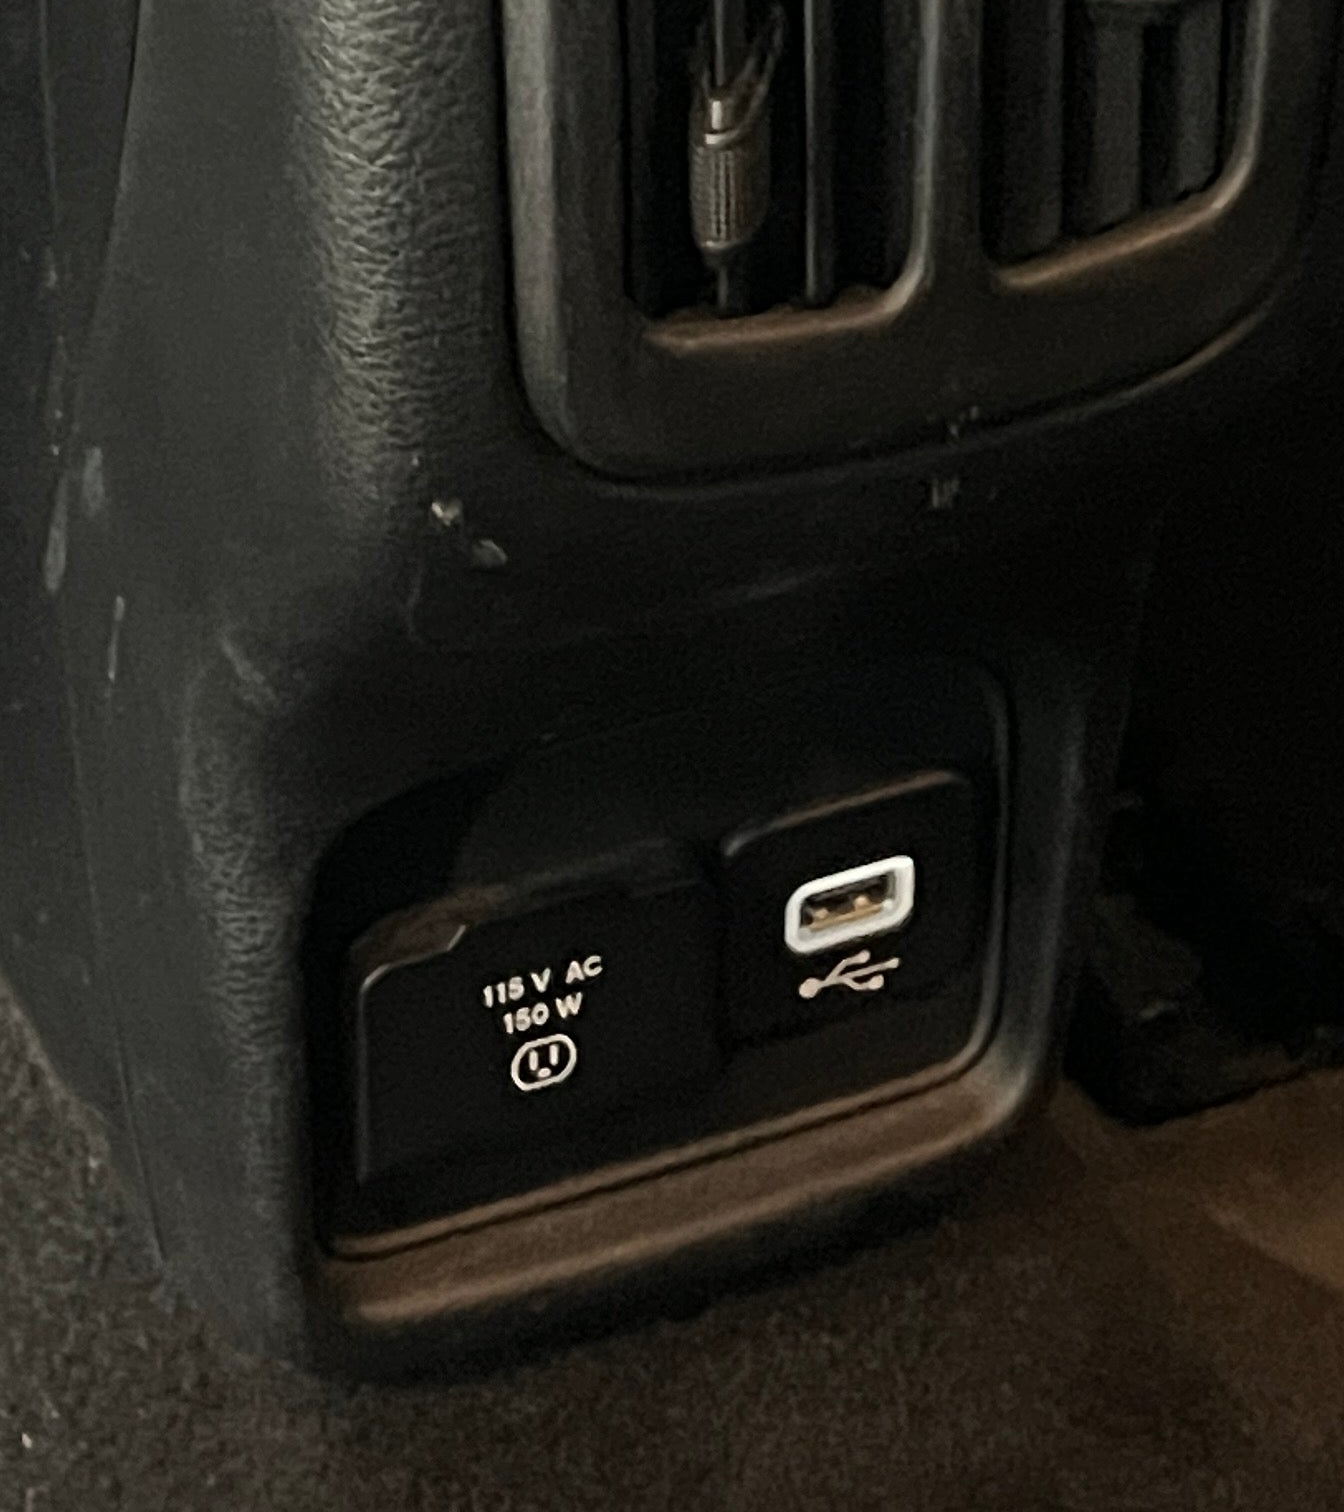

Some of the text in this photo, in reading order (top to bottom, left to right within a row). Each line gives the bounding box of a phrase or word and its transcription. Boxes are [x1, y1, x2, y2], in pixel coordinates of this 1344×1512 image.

[483, 954, 603, 1008] 115 V AC
[503, 992, 584, 1034] 150 W
